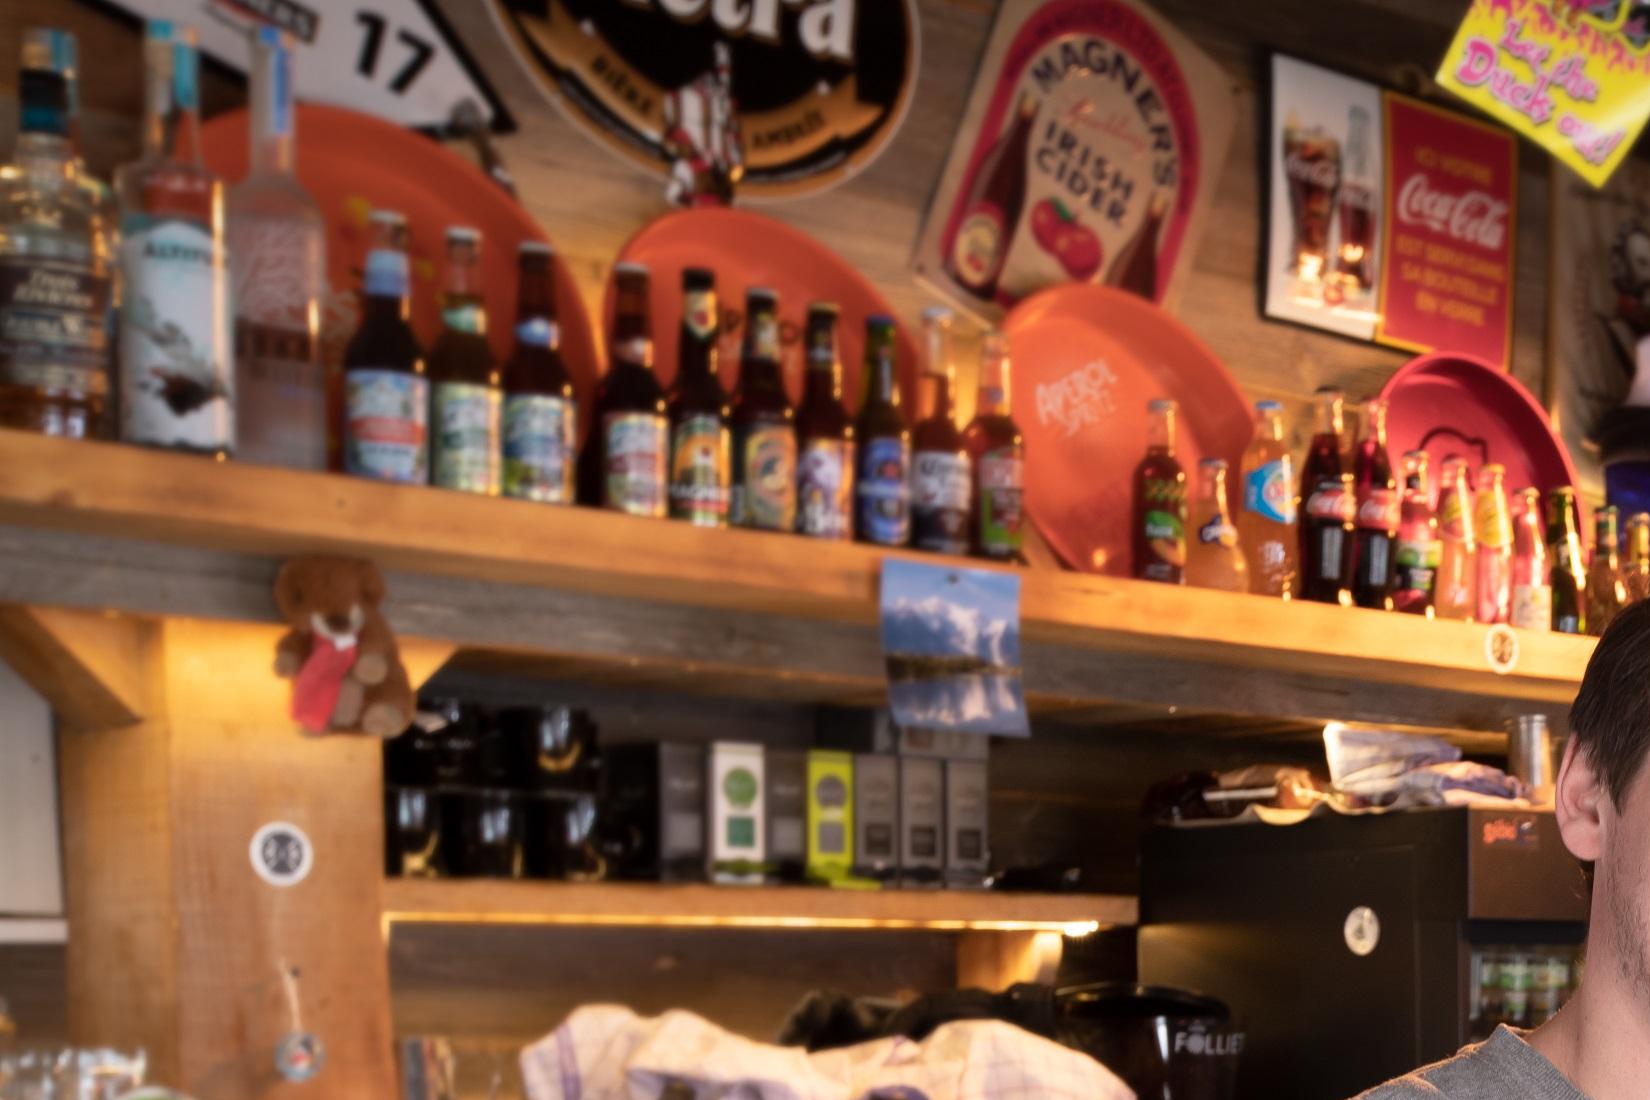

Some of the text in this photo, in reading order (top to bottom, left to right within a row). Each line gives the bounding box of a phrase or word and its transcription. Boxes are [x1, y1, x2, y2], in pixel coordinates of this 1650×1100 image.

[356, 9, 435, 96] 17
[1457, 37, 1557, 126] Duck
[1036, 147, 1127, 228] CIDER
[1045, 121, 1134, 200] IRISH
[1397, 172, 1507, 250] Coca-Cola
